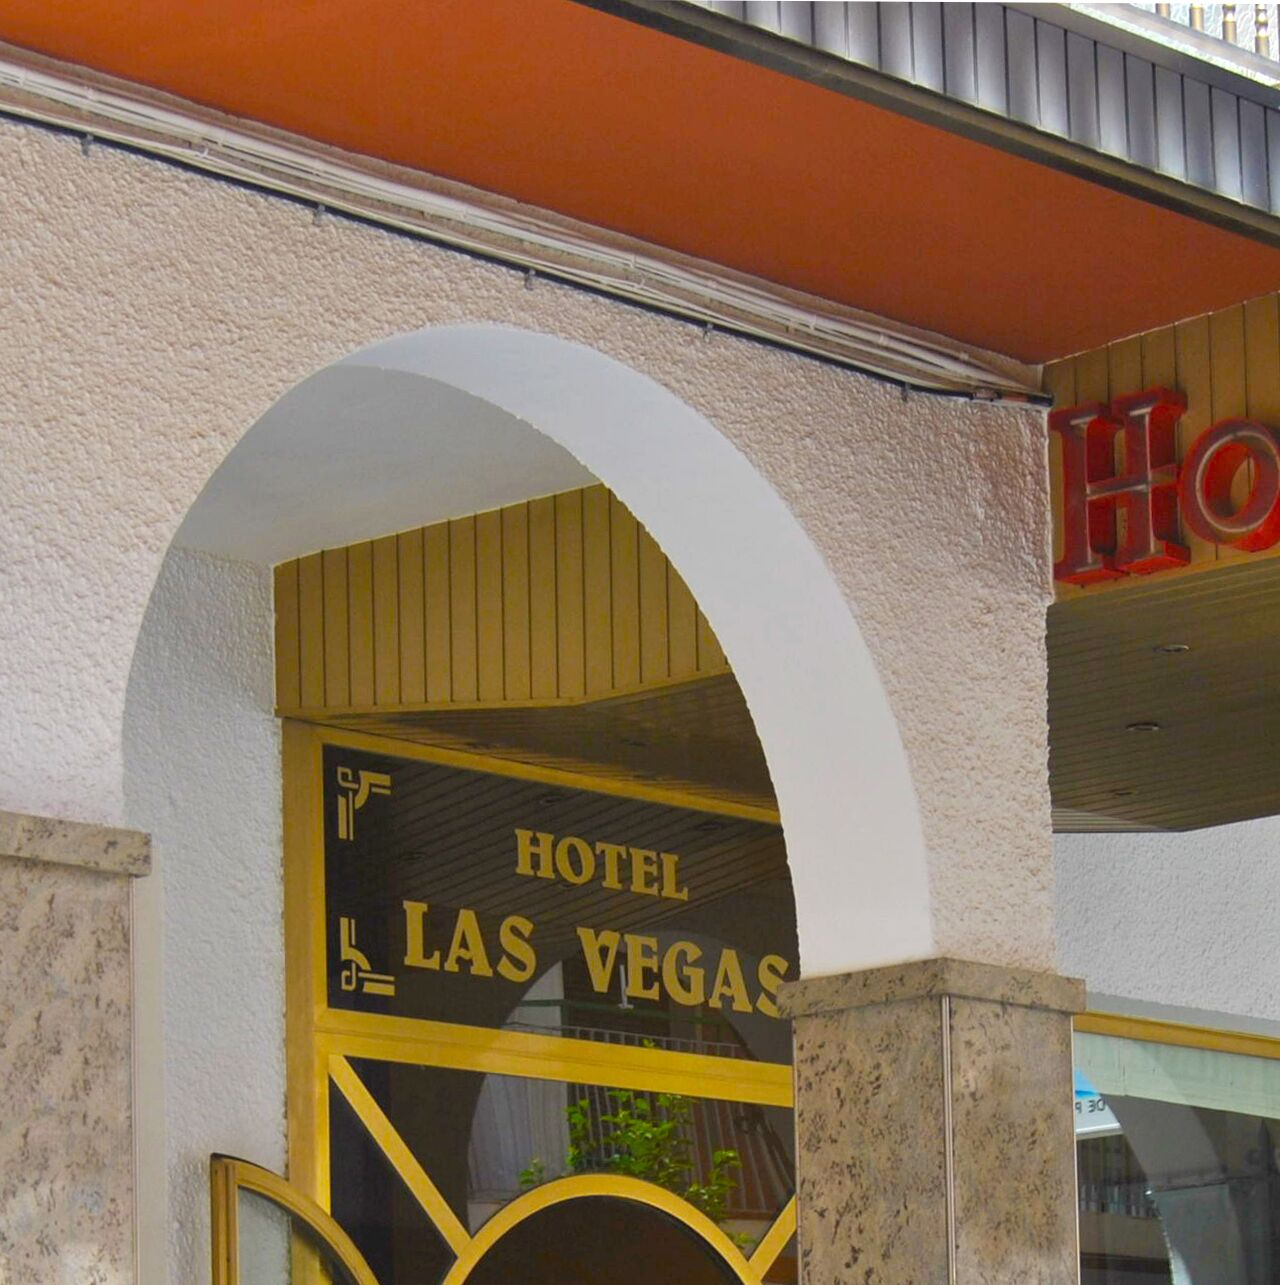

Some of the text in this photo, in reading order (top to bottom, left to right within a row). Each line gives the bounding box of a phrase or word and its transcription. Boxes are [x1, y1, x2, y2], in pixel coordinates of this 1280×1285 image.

[514, 828, 688, 901] HOTEL
[402, 900, 790, 1019] LAS VEGAS
